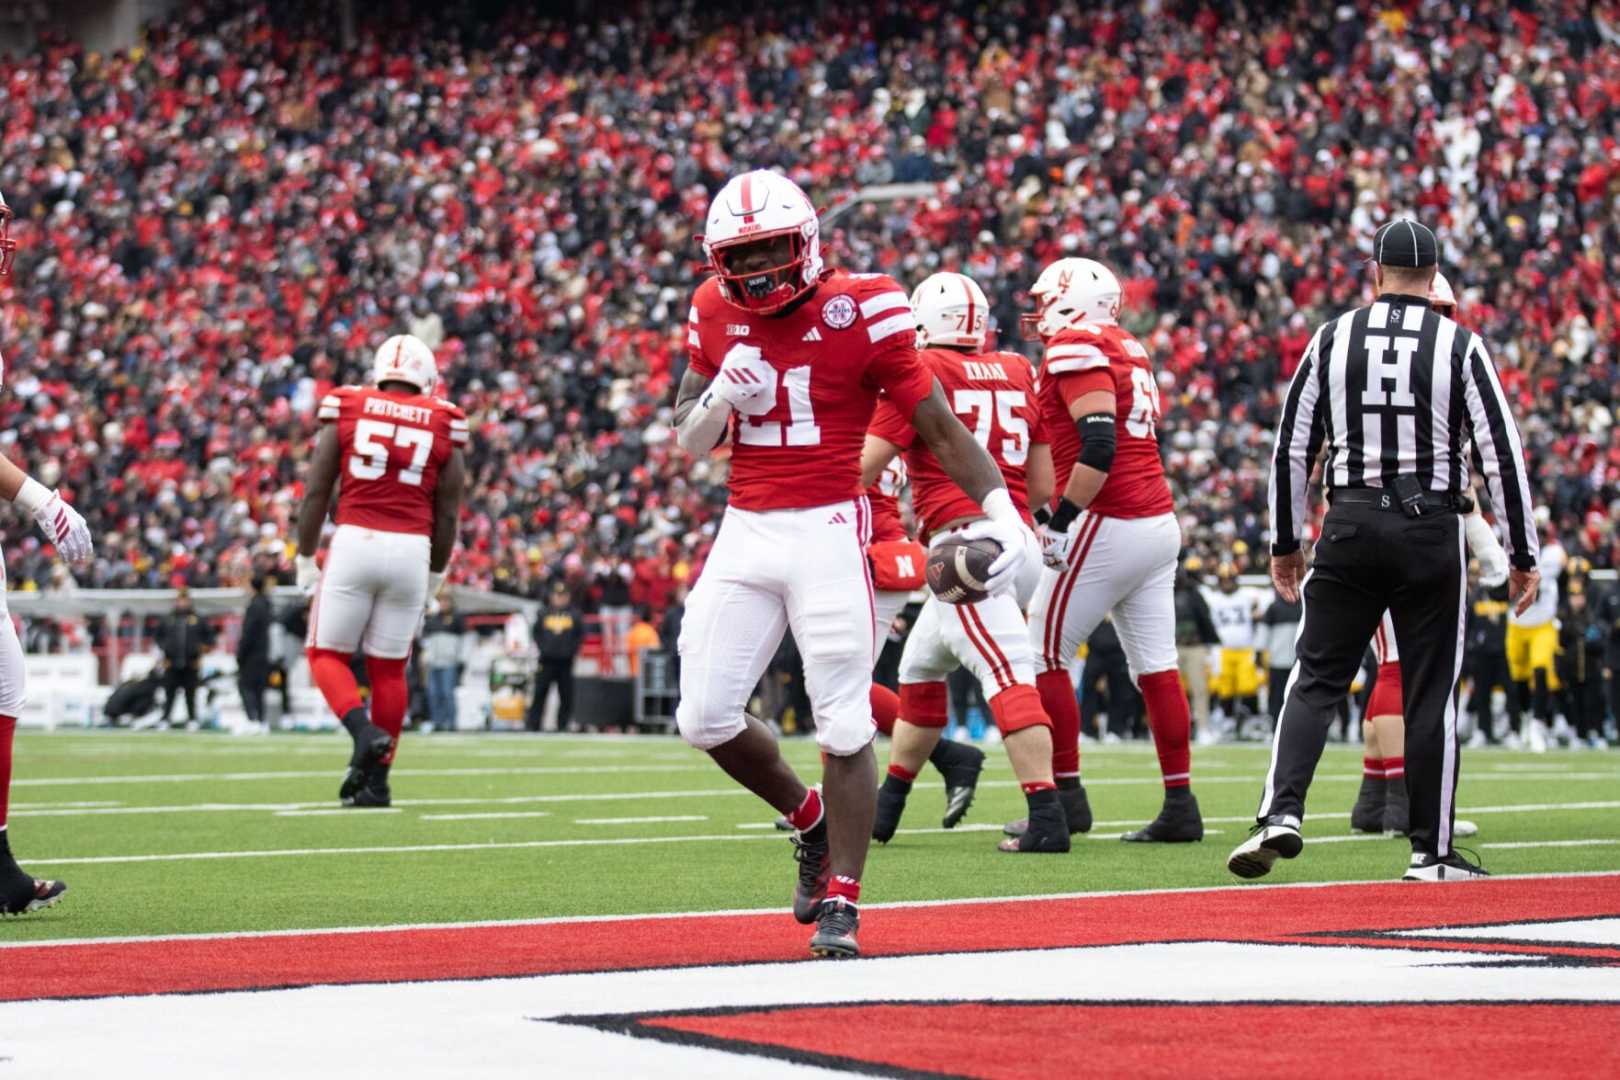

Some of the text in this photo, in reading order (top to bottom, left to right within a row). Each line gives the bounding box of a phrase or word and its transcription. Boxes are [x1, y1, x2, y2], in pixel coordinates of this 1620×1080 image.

[1361, 335, 1420, 407] H
[364, 396, 433, 425] PRITCHETT
[953, 389, 1031, 466] 75
[349, 418, 434, 486] 57
[895, 554, 916, 579] N
